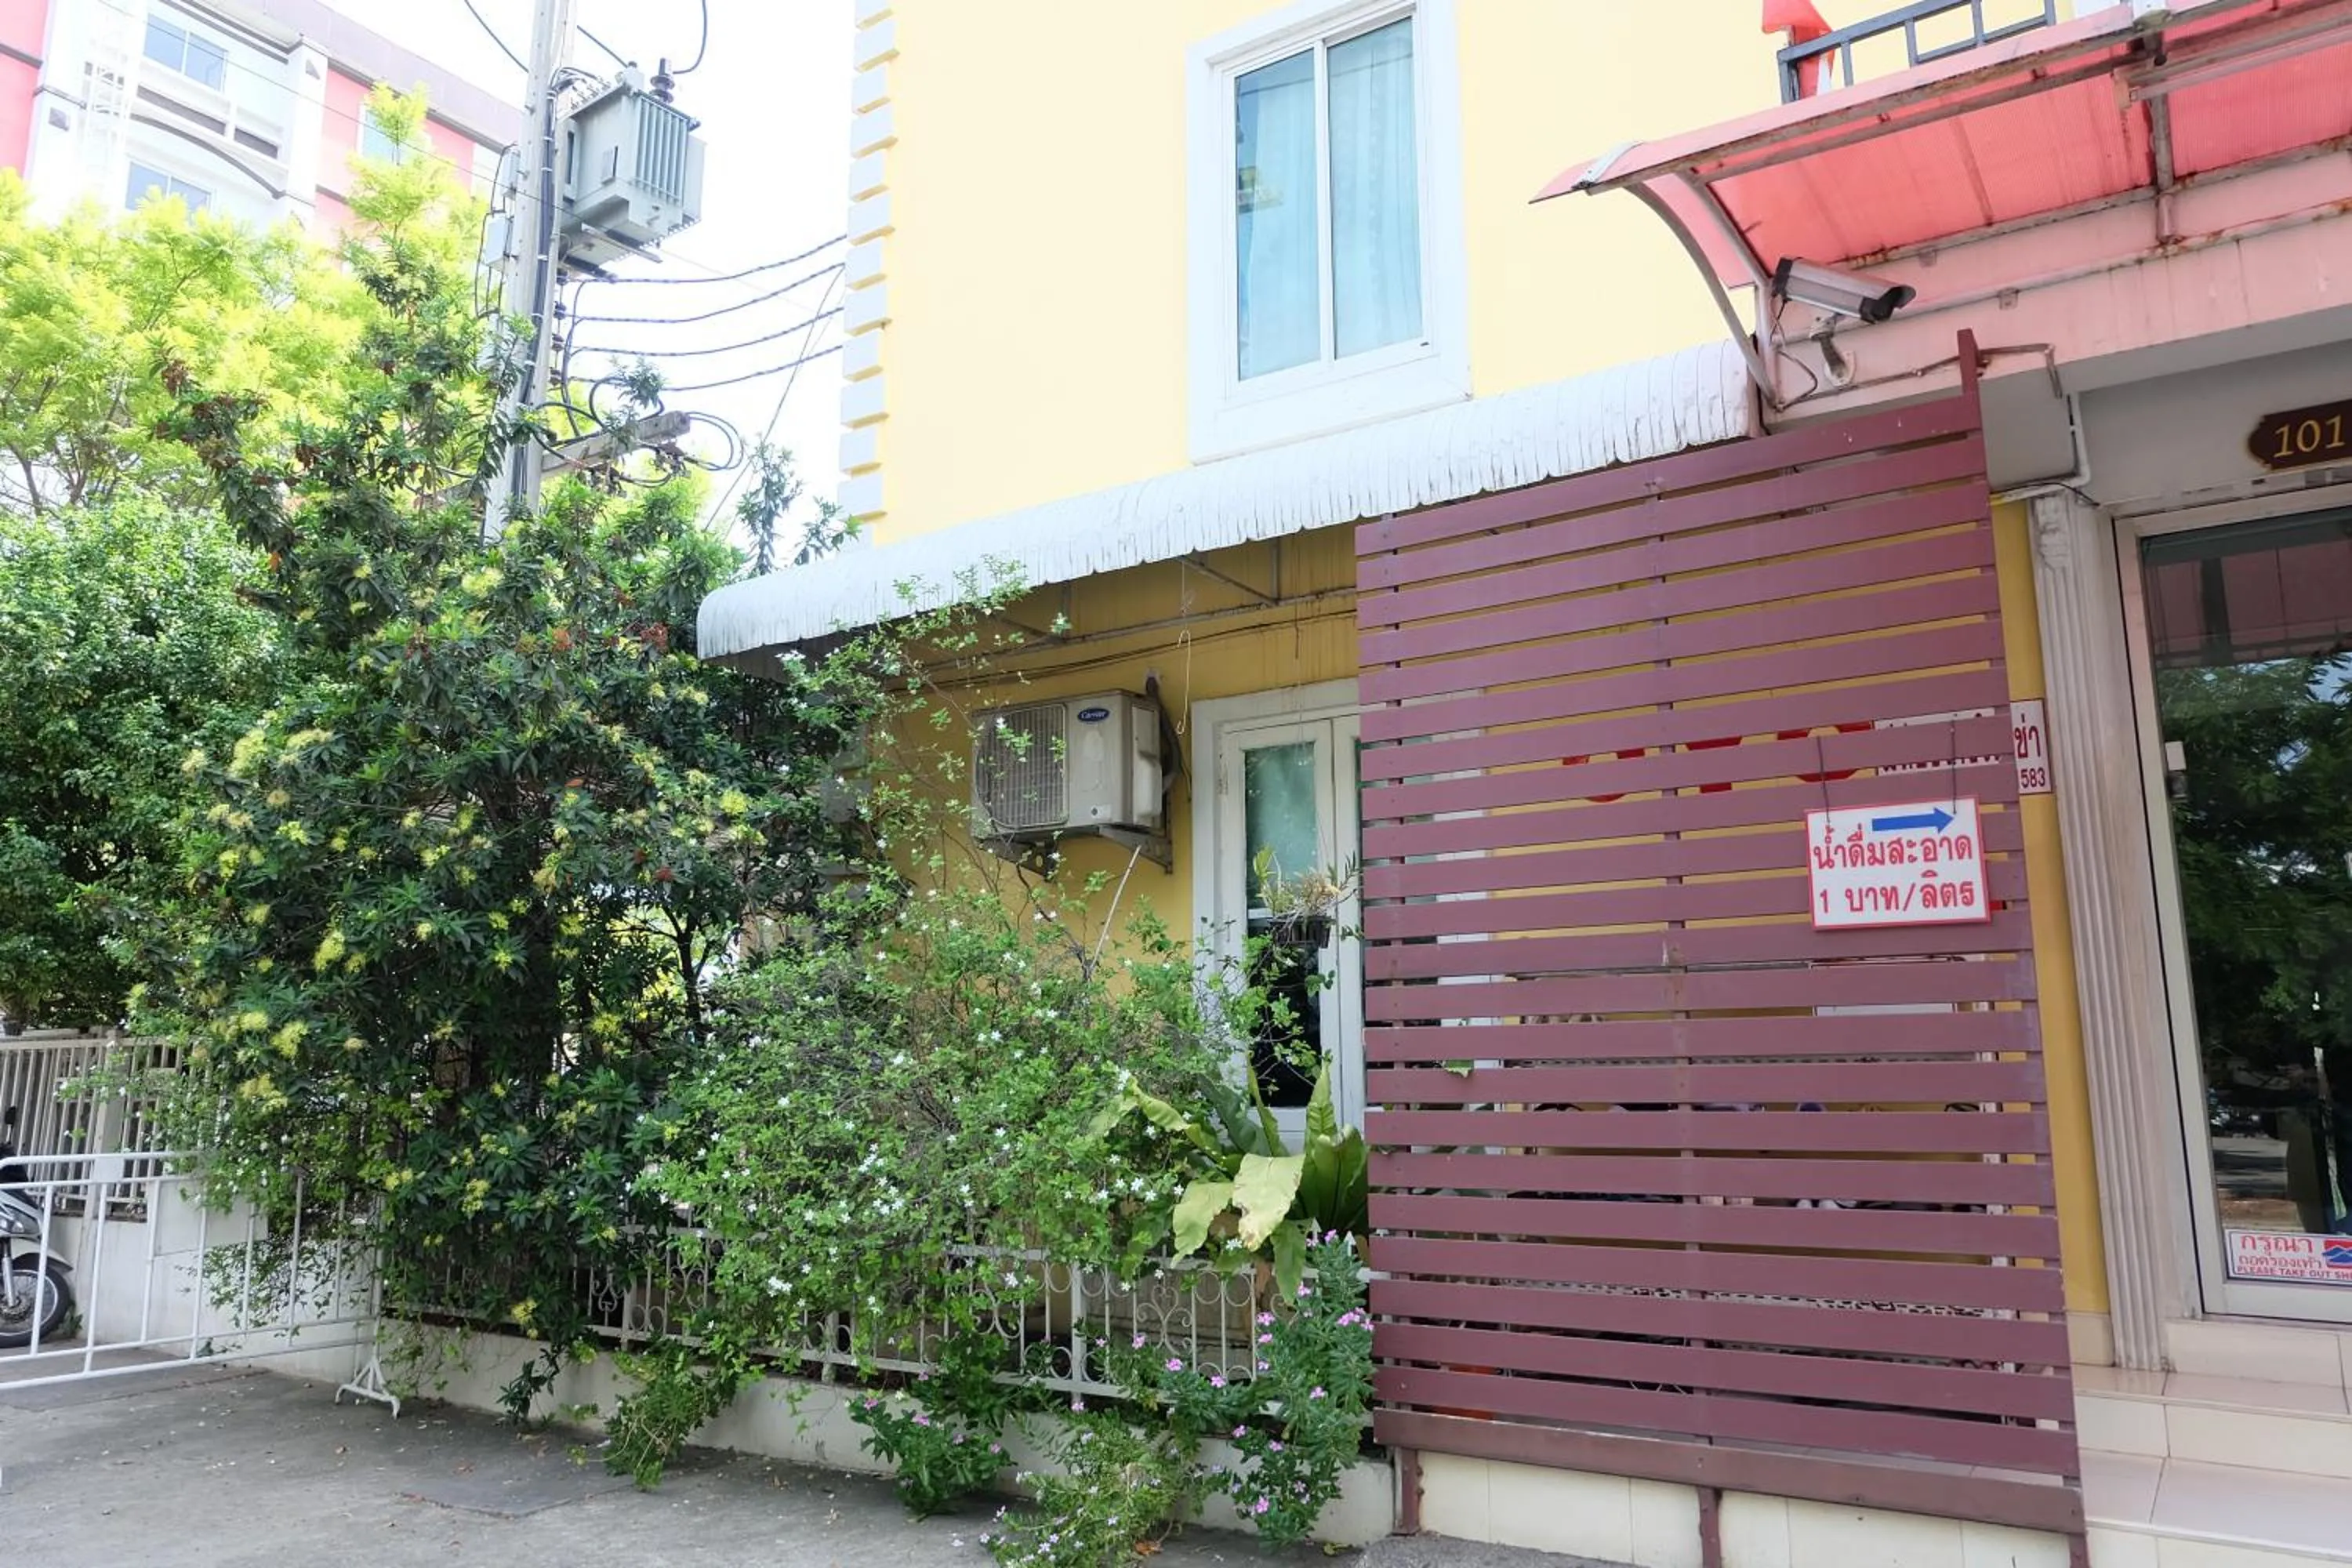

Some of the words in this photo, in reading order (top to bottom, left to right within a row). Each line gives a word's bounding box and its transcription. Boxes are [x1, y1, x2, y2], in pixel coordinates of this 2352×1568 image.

[2273, 414, 2346, 458] 101
[2020, 767, 2045, 788] 583
[1813, 823, 1973, 869] น้ำดื่มสะอาด
[1819, 889, 1829, 913] 1
[1845, 870, 1975, 913] บาท/ลิตร
[2241, 1235, 2314, 1256] กรุณา
[2237, 1265, 2275, 1276] PLEASE
[2279, 1268, 2305, 1277] TAKE
[2334, 1270, 2352, 1280] SH
